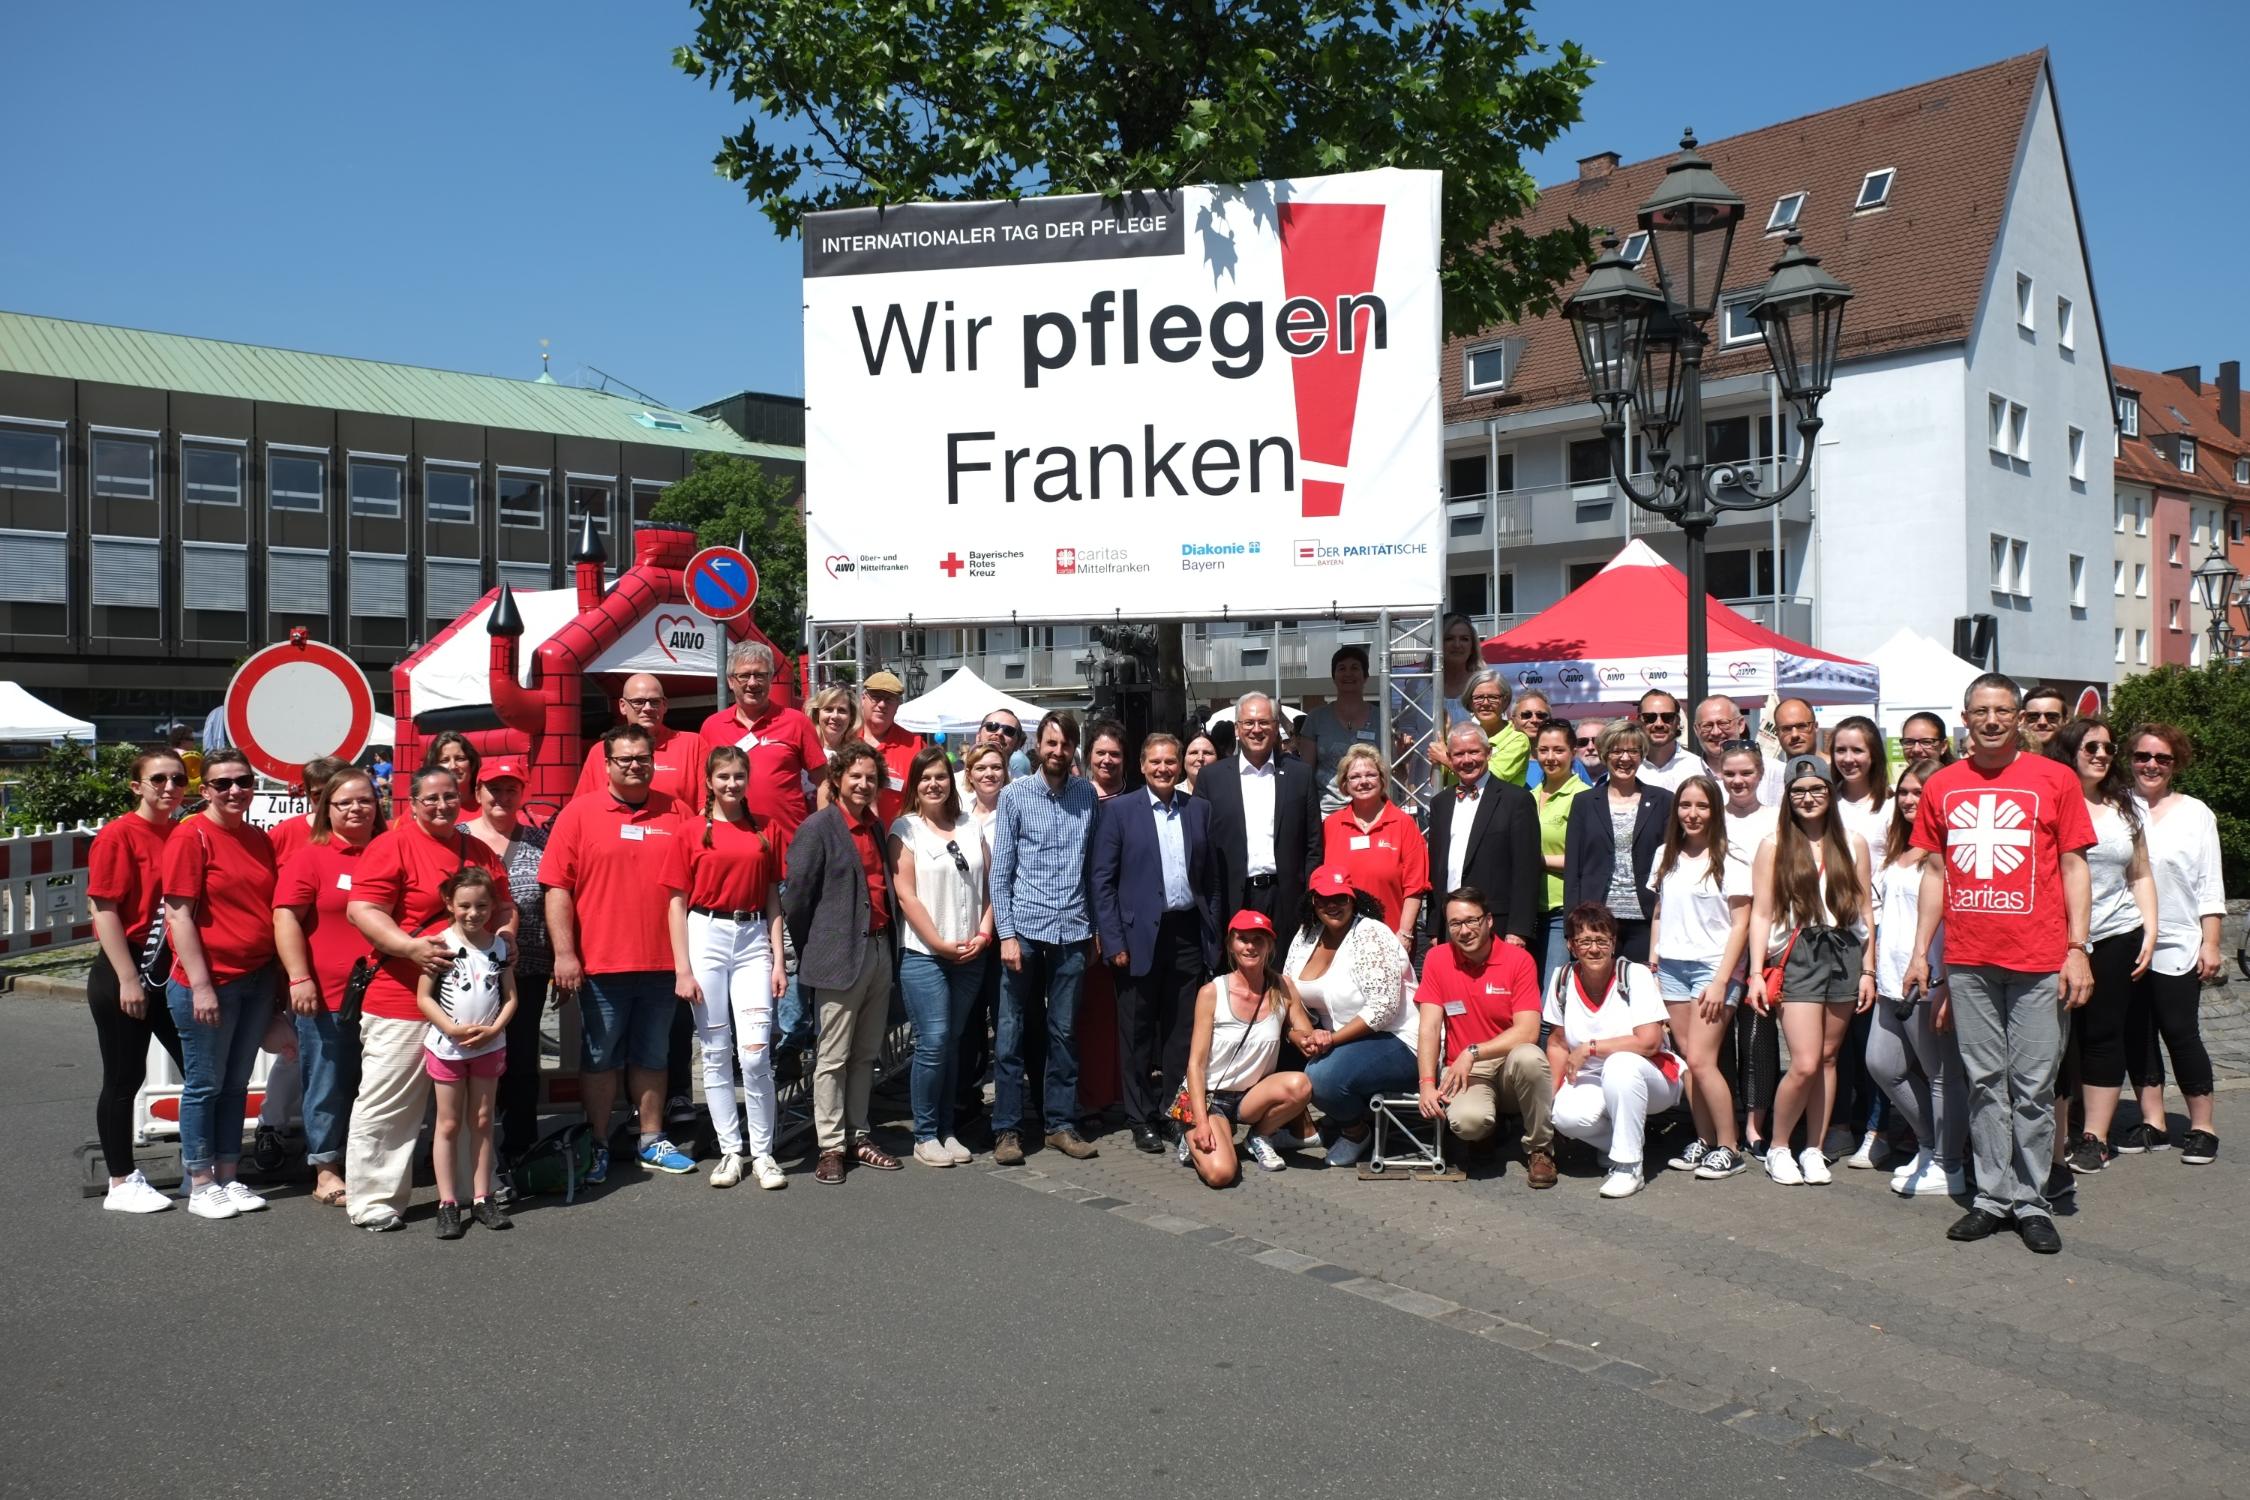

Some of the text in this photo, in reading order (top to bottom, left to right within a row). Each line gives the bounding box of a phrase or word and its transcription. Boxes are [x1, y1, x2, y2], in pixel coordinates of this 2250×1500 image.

[822, 215, 1167, 254] INTERNATIONALER TAG DER PFLEGE
[852, 288, 1388, 389] Wir pflegen
[1077, 546, 1128, 561] caritas
[1181, 542, 1245, 556] Diakonie
[1317, 543, 1428, 558] DER PARITÄTISCHE
[859, 553, 898, 562] Ober- und
[969, 550, 1025, 562] Bayerisches
[835, 562, 856, 573] AWO
[860, 563, 909, 573] Mittelfranken
[969, 559, 996, 569] Rotes
[1077, 562, 1150, 575] Mittelfranken
[1181, 558, 1225, 573] Bayern
[969, 568, 996, 578] Kreuz
[669, 630, 705, 650] AWO
[1525, 675, 1543, 685] AWO
[1565, 674, 1584, 683] AWO
[1606, 672, 1625, 682] AWO
[1648, 671, 1668, 680] AWO
